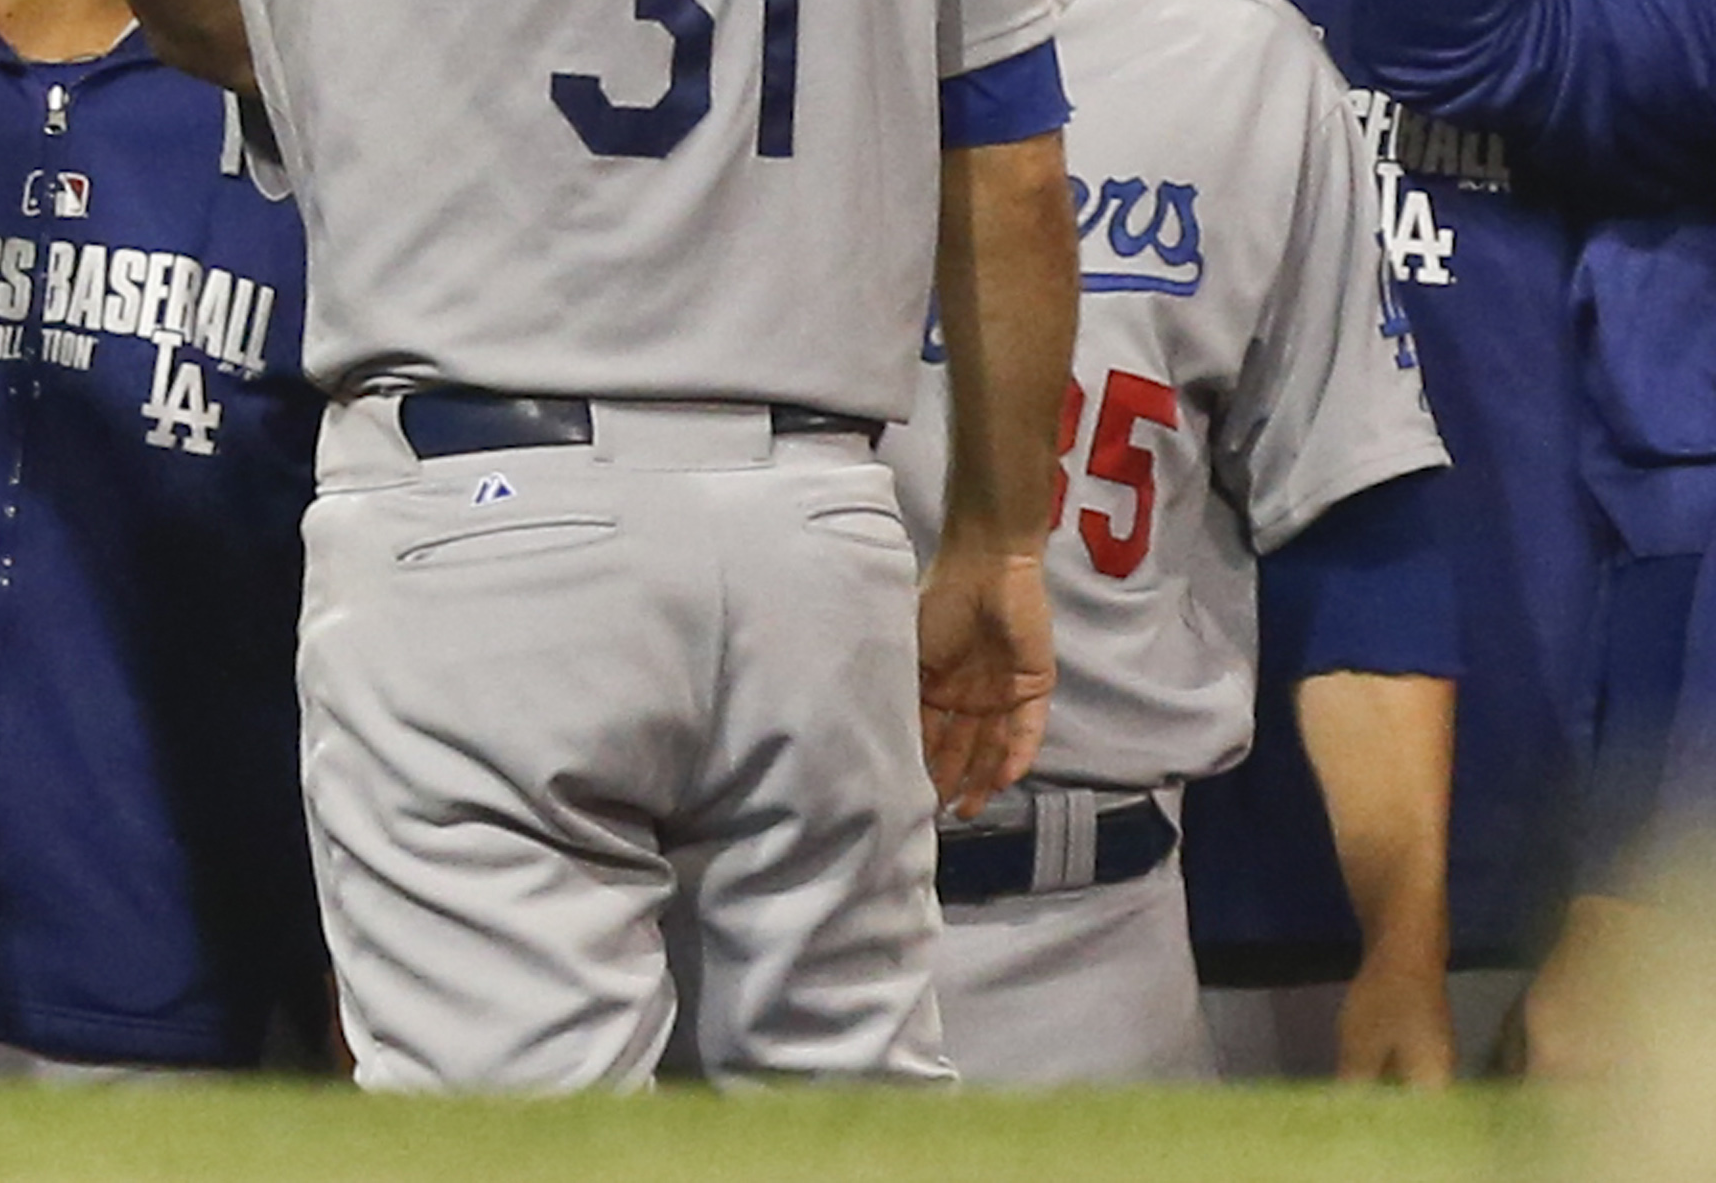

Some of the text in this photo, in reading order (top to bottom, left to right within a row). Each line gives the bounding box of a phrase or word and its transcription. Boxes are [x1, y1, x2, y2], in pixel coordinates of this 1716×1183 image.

[1376, 161, 1455, 285] LA
[42, 239, 276, 374] BASEBALL
[141, 328, 222, 455] LA
